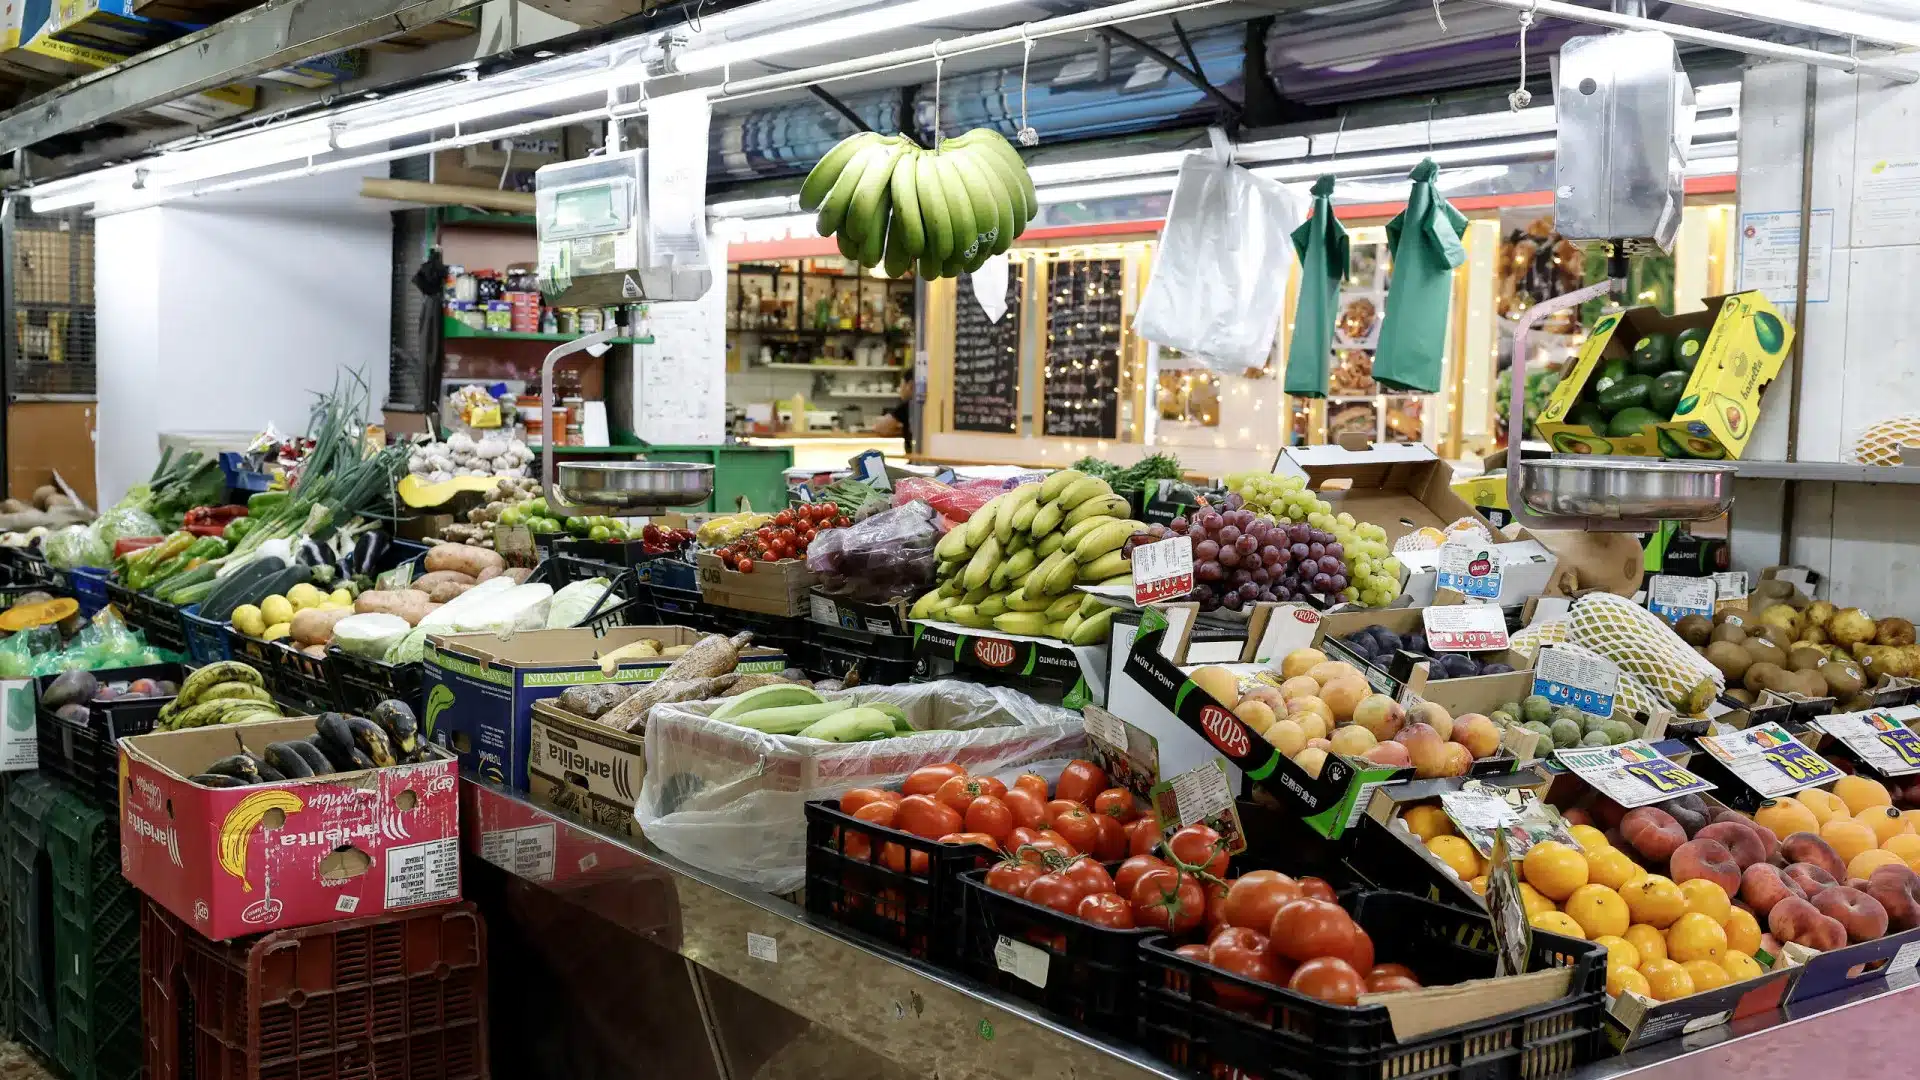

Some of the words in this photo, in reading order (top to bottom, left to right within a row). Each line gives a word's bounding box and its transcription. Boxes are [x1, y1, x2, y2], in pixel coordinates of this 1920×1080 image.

[1294, 610, 1319, 623] TROPS
[921, 633, 931, 641] EAT
[938, 635, 955, 646] READY
[976, 641, 1014, 665] TROPS
[1039, 656, 1059, 665] PUNTO
[1068, 660, 1077, 668] EN
[528, 672, 585, 683] PLANTAIN
[1133, 653, 1150, 670] MÛR
[1155, 670, 1176, 691] POINT
[1203, 708, 1249, 756] TROPS
[1564, 754, 1613, 768] FRUTAS
